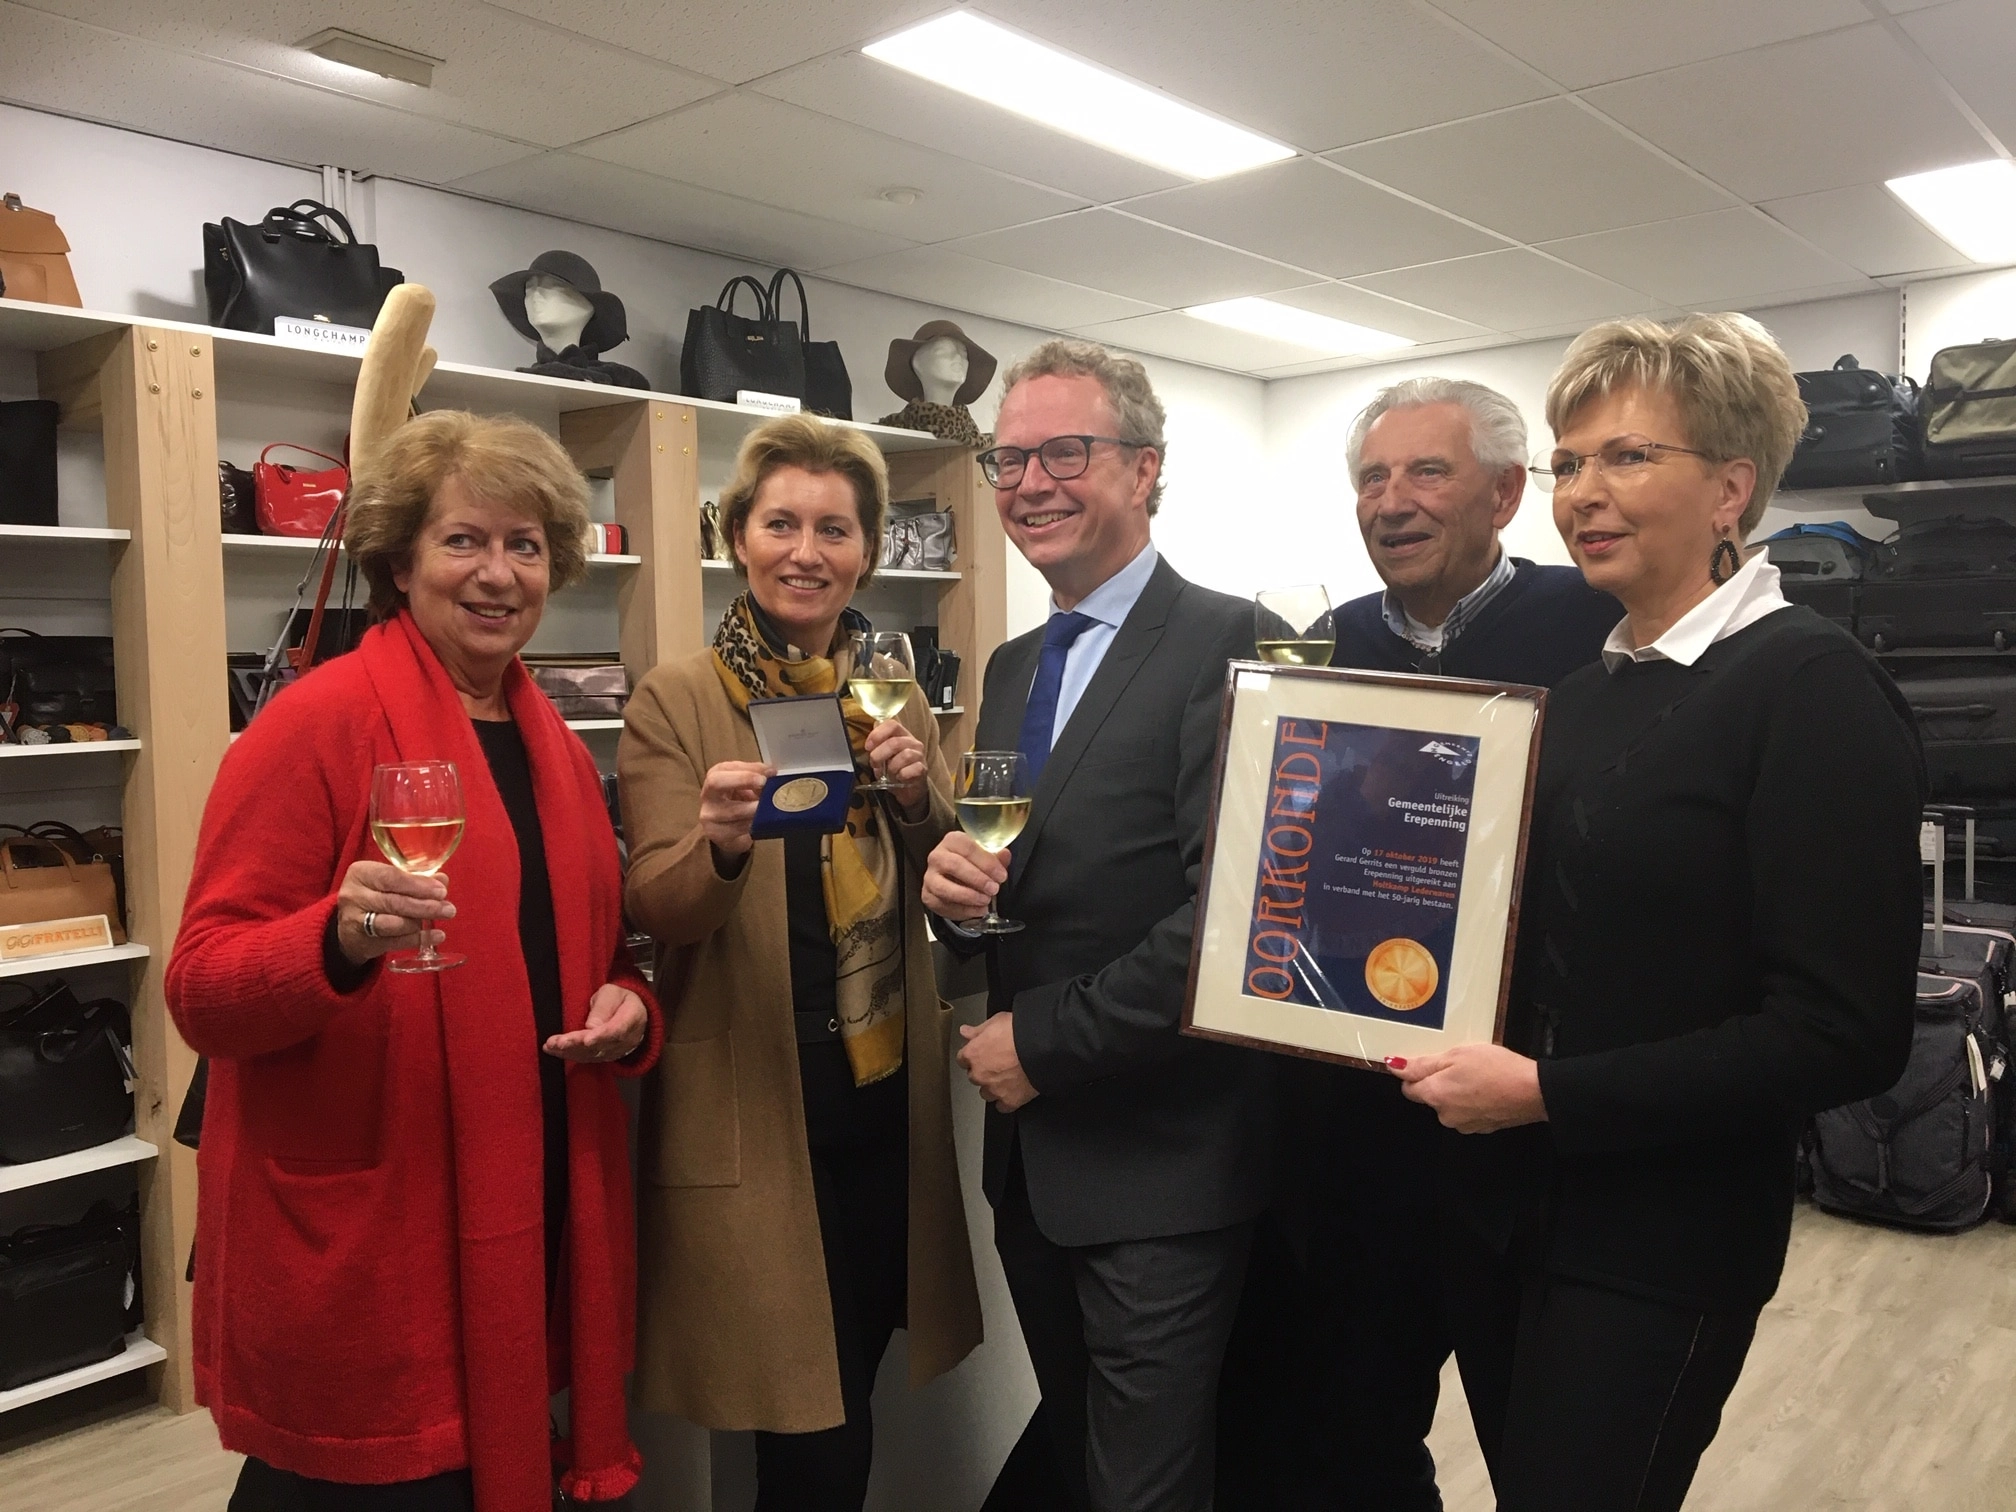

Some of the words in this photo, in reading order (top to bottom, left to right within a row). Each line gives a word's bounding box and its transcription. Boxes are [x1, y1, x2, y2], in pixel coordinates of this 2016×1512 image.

[287, 324, 366, 344] LONGCHAMP
[1388, 797, 1468, 817] Gemeentelijke
[1434, 792, 1470, 805] Uitreiking
[1404, 813, 1466, 832] Erepenning
[1248, 721, 1328, 1000] OORKONDE
[1334, 853, 1357, 864] Gerard
[1359, 857, 1383, 868] Gerrits
[1400, 864, 1427, 874] verguld
[1428, 867, 1458, 878] bronzen
[1362, 847, 1372, 856] Op
[1374, 849, 1384, 857] 17
[1385, 850, 1415, 861] oktober
[1417, 855, 1438, 865] 2019
[1440, 858, 1459, 868] heeft
[1363, 868, 1403, 882] Erepenning
[1405, 875, 1441, 886] uitgereikt
[1442, 881, 1456, 889] aan
[1332, 884, 1360, 895] verband
[1362, 889, 1376, 898] met
[1378, 891, 1390, 900] het
[1392, 893, 1420, 906] 50-jarig
[1422, 898, 1453, 909] bestaan.
[1372, 880, 1409, 893] Holtkamp
[1411, 885, 1455, 899] Lederwaren
